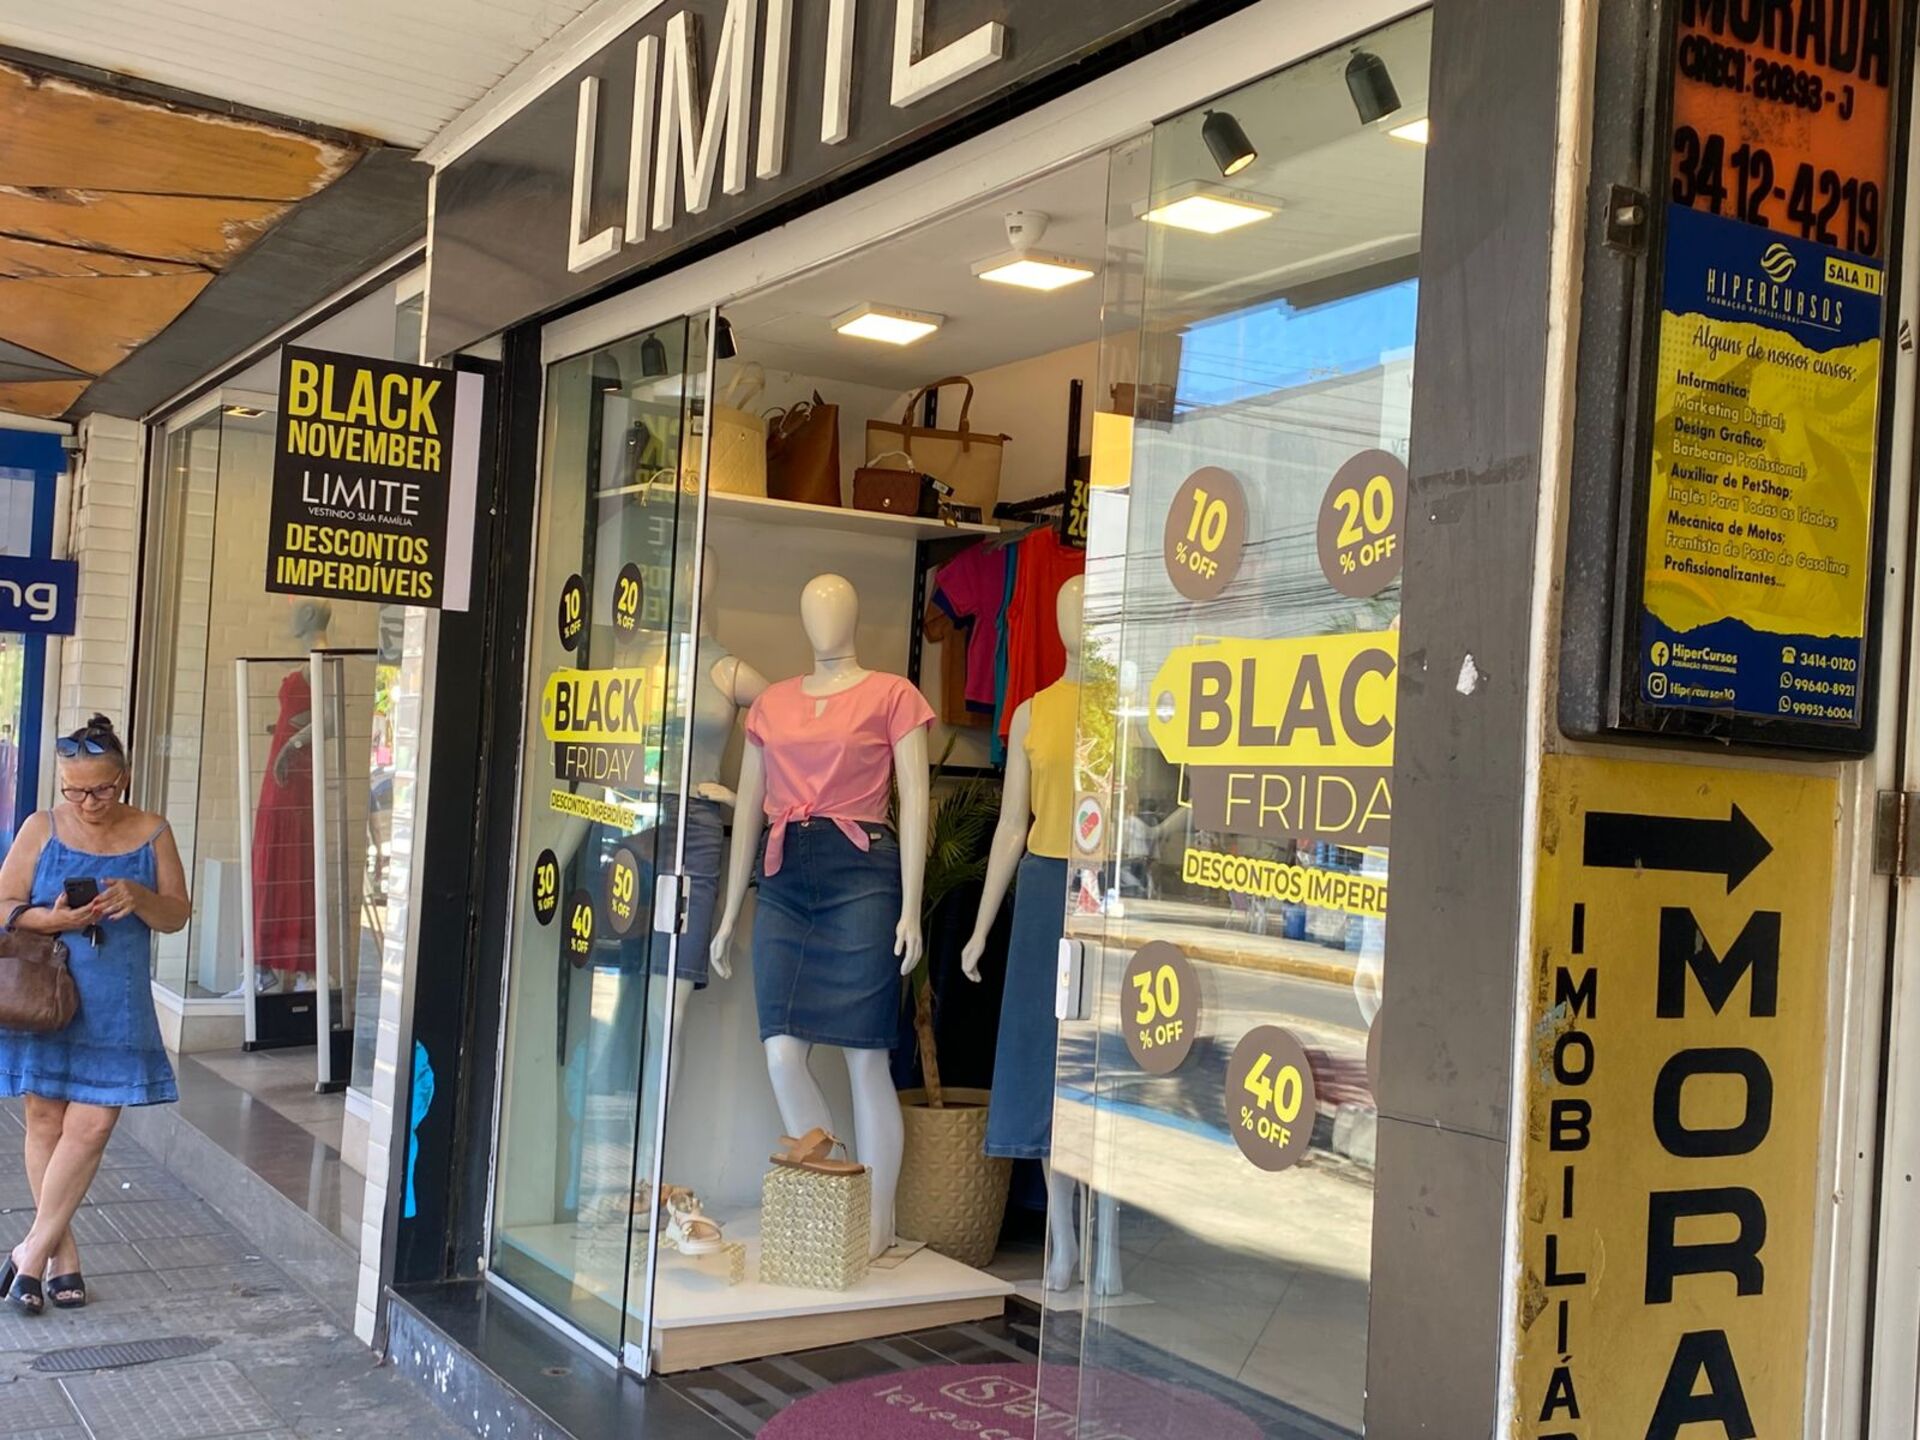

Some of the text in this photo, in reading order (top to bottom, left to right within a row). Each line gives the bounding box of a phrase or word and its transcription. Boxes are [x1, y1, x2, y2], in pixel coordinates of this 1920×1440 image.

[1828, 264, 1874, 289] SALA 11
[1707, 268, 1843, 326] HIPERCURSOS
[1748, 306, 1801, 324] PROFISSIONAL
[1692, 324, 1857, 382] Alguns de nossos cursos:
[288, 359, 442, 435] BLACK
[1674, 391, 1739, 422] Marketing
[288, 420, 441, 472] NOVEMBER
[1674, 417, 1715, 441] Design
[1672, 438, 1734, 465] Barbearia
[302, 471, 420, 515] LIMITE
[1671, 463, 1718, 485] Auxiliar
[1723, 473, 1738, 488] de
[308, 507, 412, 526] VESTINDO SUA FAMÍLIA
[1186, 487, 1229, 553] 10
[1333, 475, 1394, 550] 20
[1710, 491, 1738, 511] Para
[1744, 496, 1777, 518] Todas
[1781, 508, 1795, 520] as
[286, 523, 429, 564] DESCONTOS
[1728, 520, 1743, 536] de
[1175, 541, 1219, 581] % OFF
[1339, 534, 1396, 575] % OFF
[1665, 530, 1720, 554] Frentista
[1724, 541, 1739, 557] de
[1743, 543, 1774, 563] Posto
[1777, 548, 1793, 565] de
[276, 556, 433, 599] IMPERDÍVEIS
[565, 588, 580, 623] 10
[618, 578, 638, 615] 20
[569, 619, 581, 635] OFF
[622, 615, 635, 631] OFF
[1673, 643, 1856, 672] HiperCursos 3414-0120
[1794, 678, 1855, 697] 99640-8921
[554, 678, 643, 733] BLACK
[1793, 702, 1853, 720] 99952-6004
[564, 746, 634, 782] FRIDAY
[552, 792, 590, 816] DESCONTOS
[537, 863, 555, 897] 30
[613, 864, 633, 903] 50
[1186, 854, 1301, 897] DESCONTOS
[543, 895, 555, 910] OFF
[617, 902, 630, 919] OFF
[572, 904, 592, 939] 40
[576, 939, 589, 954] OFF
[1132, 964, 1180, 1025] 30
[1139, 1020, 1183, 1049] % OFF
[1243, 1052, 1303, 1123] 40
[1240, 1106, 1291, 1148] % OFF
[1538, 902, 1597, 1440] IMOBILIÁ
[1645, 906, 1783, 1440] MORA
